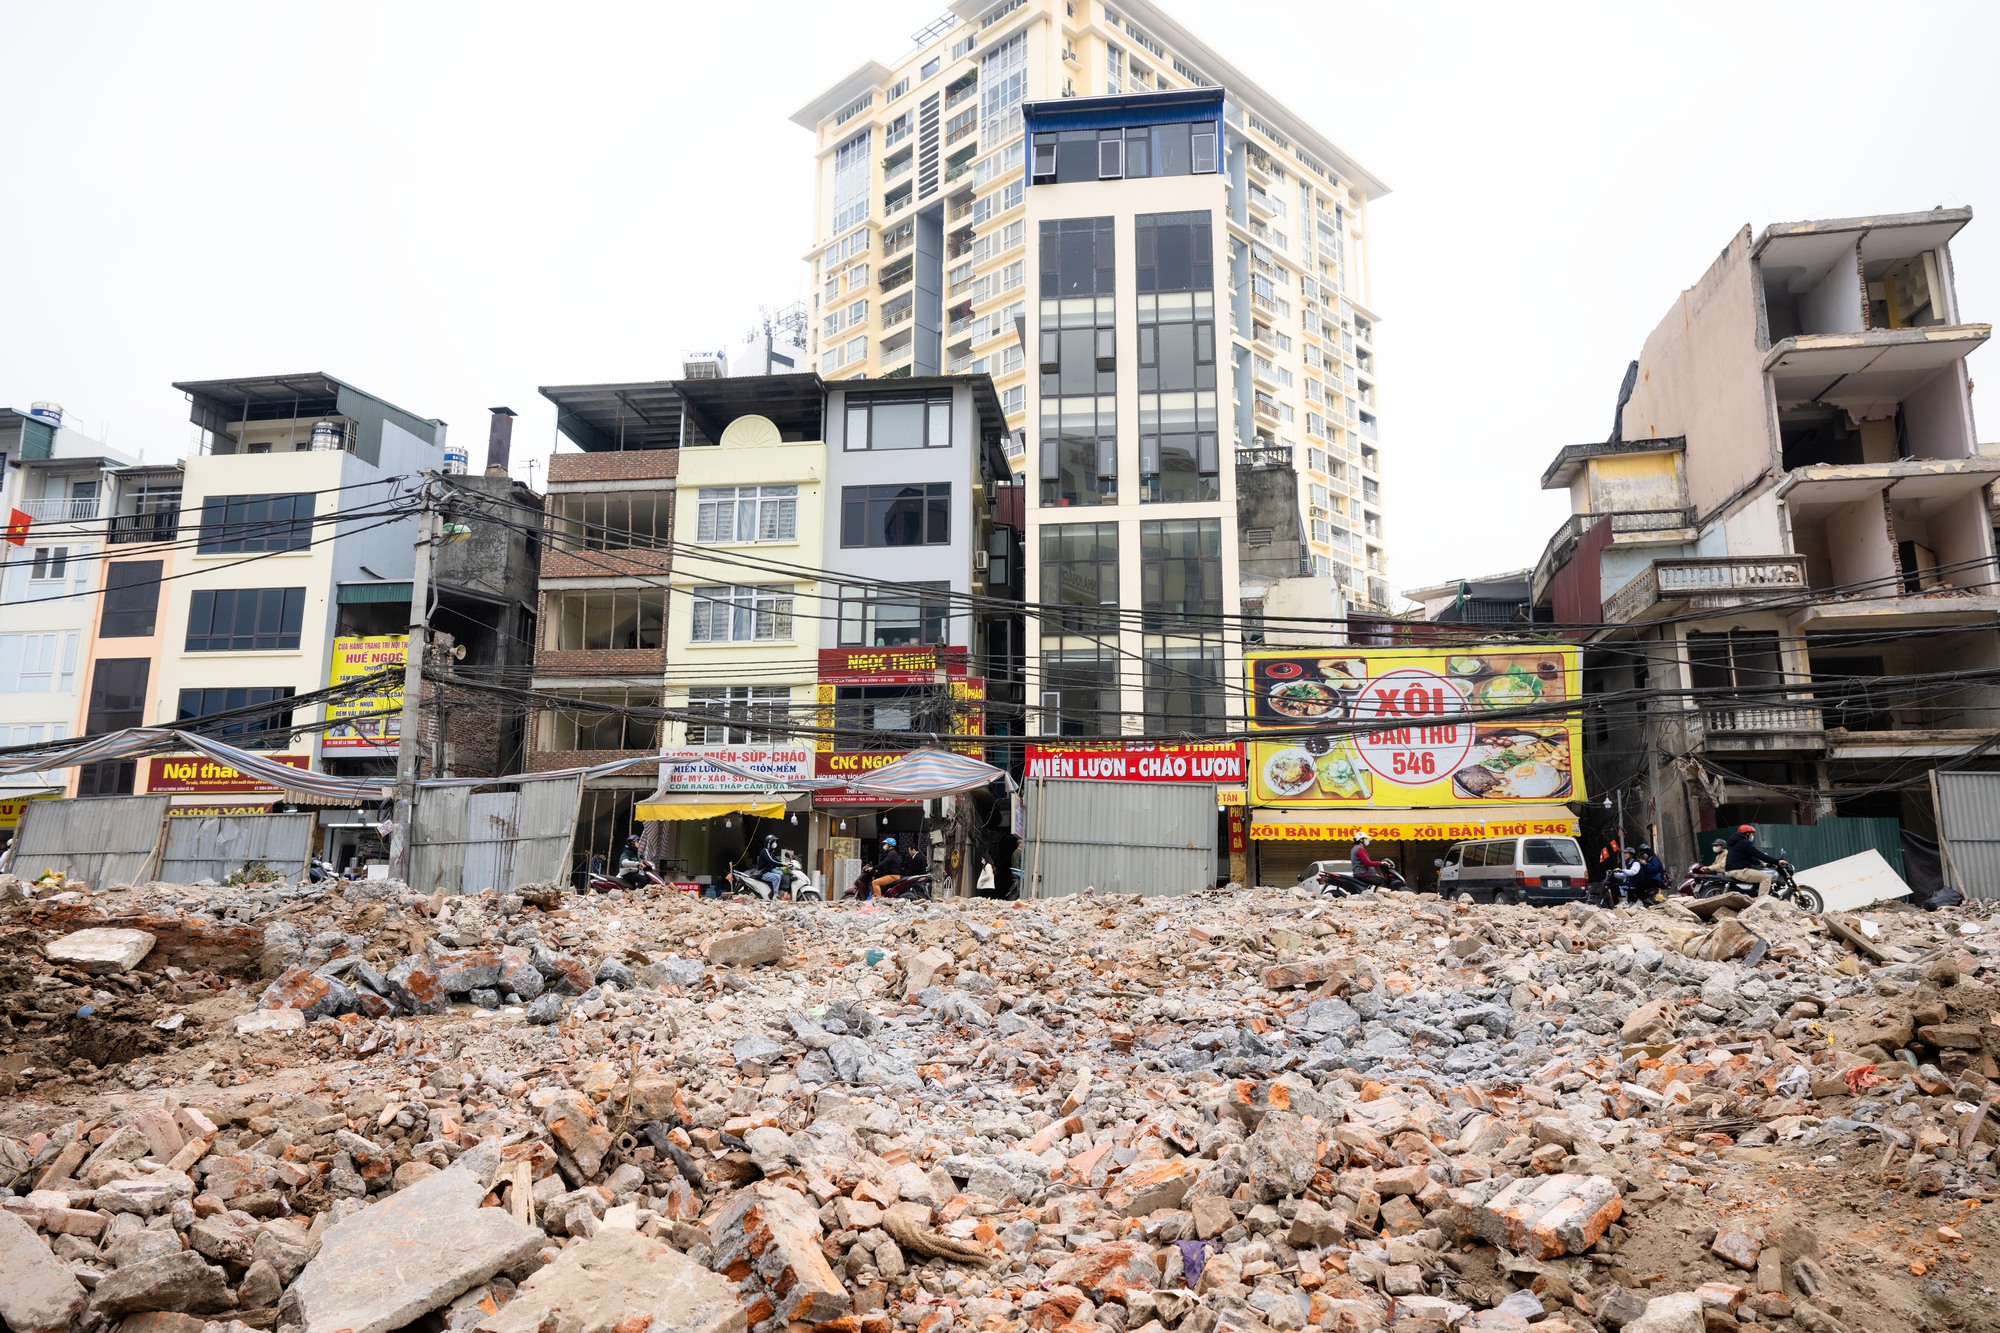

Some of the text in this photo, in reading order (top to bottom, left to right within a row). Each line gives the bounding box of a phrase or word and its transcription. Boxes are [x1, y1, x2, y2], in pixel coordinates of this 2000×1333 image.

[346, 651, 369, 663] HUẾ
[848, 653, 936, 674] NGỌC THỊNH
[1374, 682, 1445, 717] XÔI
[164, 762, 198, 782] Nội
[673, 761, 697, 773] MIẾN
[830, 756, 858, 770] CNC
[1029, 753, 1074, 778] MIẾN
[1079, 756, 1126, 778] LƯƠN
[1138, 753, 1187, 778] CHÁO
[1192, 757, 1241, 777] LƯƠN
[1392, 752, 1436, 775] 546
[1251, 824, 1279, 837] XÔI
[1285, 824, 1321, 837] BÀN
[1326, 825, 1363, 837] THỜ
[1368, 828, 1401, 837] 546
[1413, 824, 1443, 837] XÔI
[1449, 825, 1485, 837] BÀN
[1490, 822, 1528, 835] THỜ
[1533, 823, 1567, 834] 546
